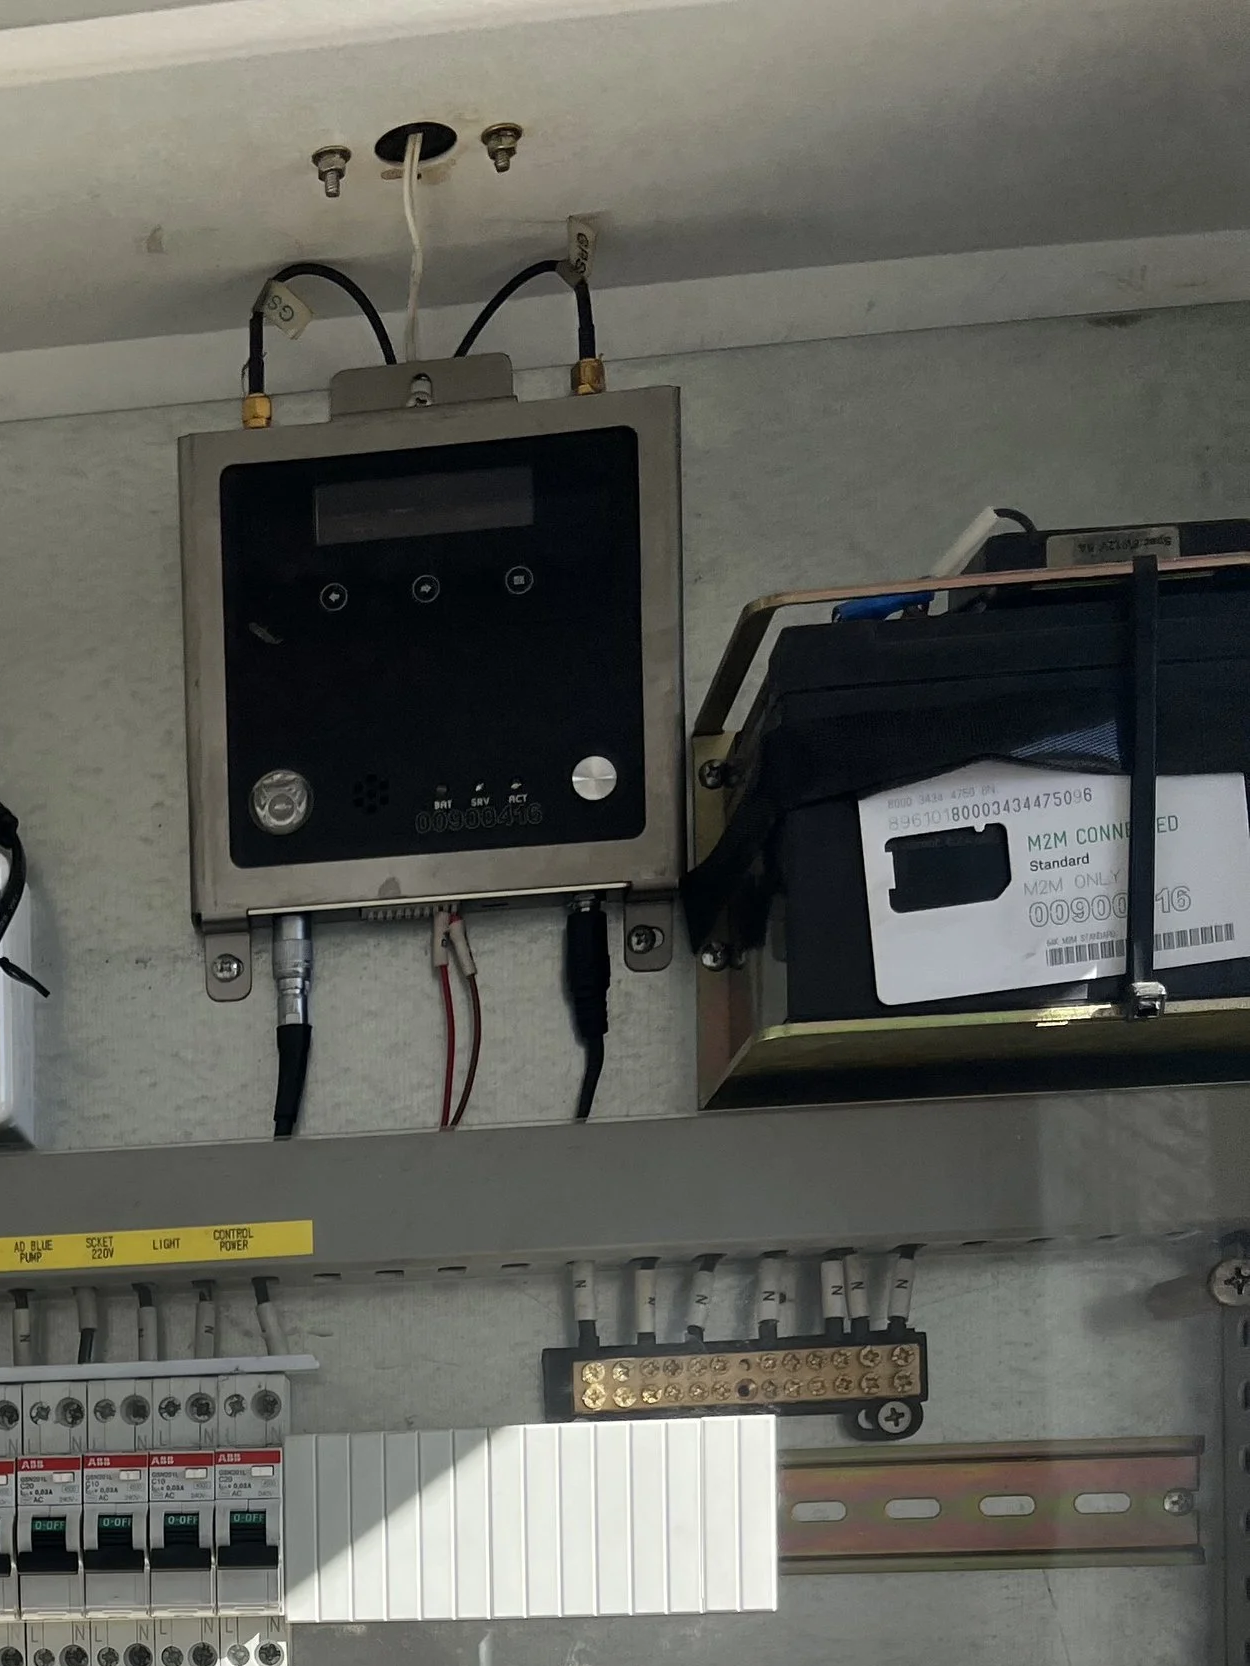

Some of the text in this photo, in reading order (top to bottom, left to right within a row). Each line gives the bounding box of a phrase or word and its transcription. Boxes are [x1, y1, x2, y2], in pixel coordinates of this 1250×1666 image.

[471, 797, 490, 807] SRV
[508, 794, 528, 803] ACT
[434, 800, 452, 810] BAT
[1027, 815, 1179, 852] M2M CONNEED
[1029, 852, 1090, 872] Standard
[1023, 867, 1119, 896] M2M ONLY
[1028, 885, 1192, 928] 0090016
[213, 1228, 254, 1240] CONTROL
[14, 1239, 54, 1252] AD BLUE
[152, 1239, 180, 1250] LIGHT
[219, 1240, 248, 1252] POWER
[20, 1252, 42, 1264] PUMP
[91, 1248, 114, 1259] 220V
[88, 1458, 111, 1466] ABB
[151, 1456, 174, 1465] ABB
[218, 1453, 241, 1463] ABB
[22, 1460, 44, 1469] ABB
